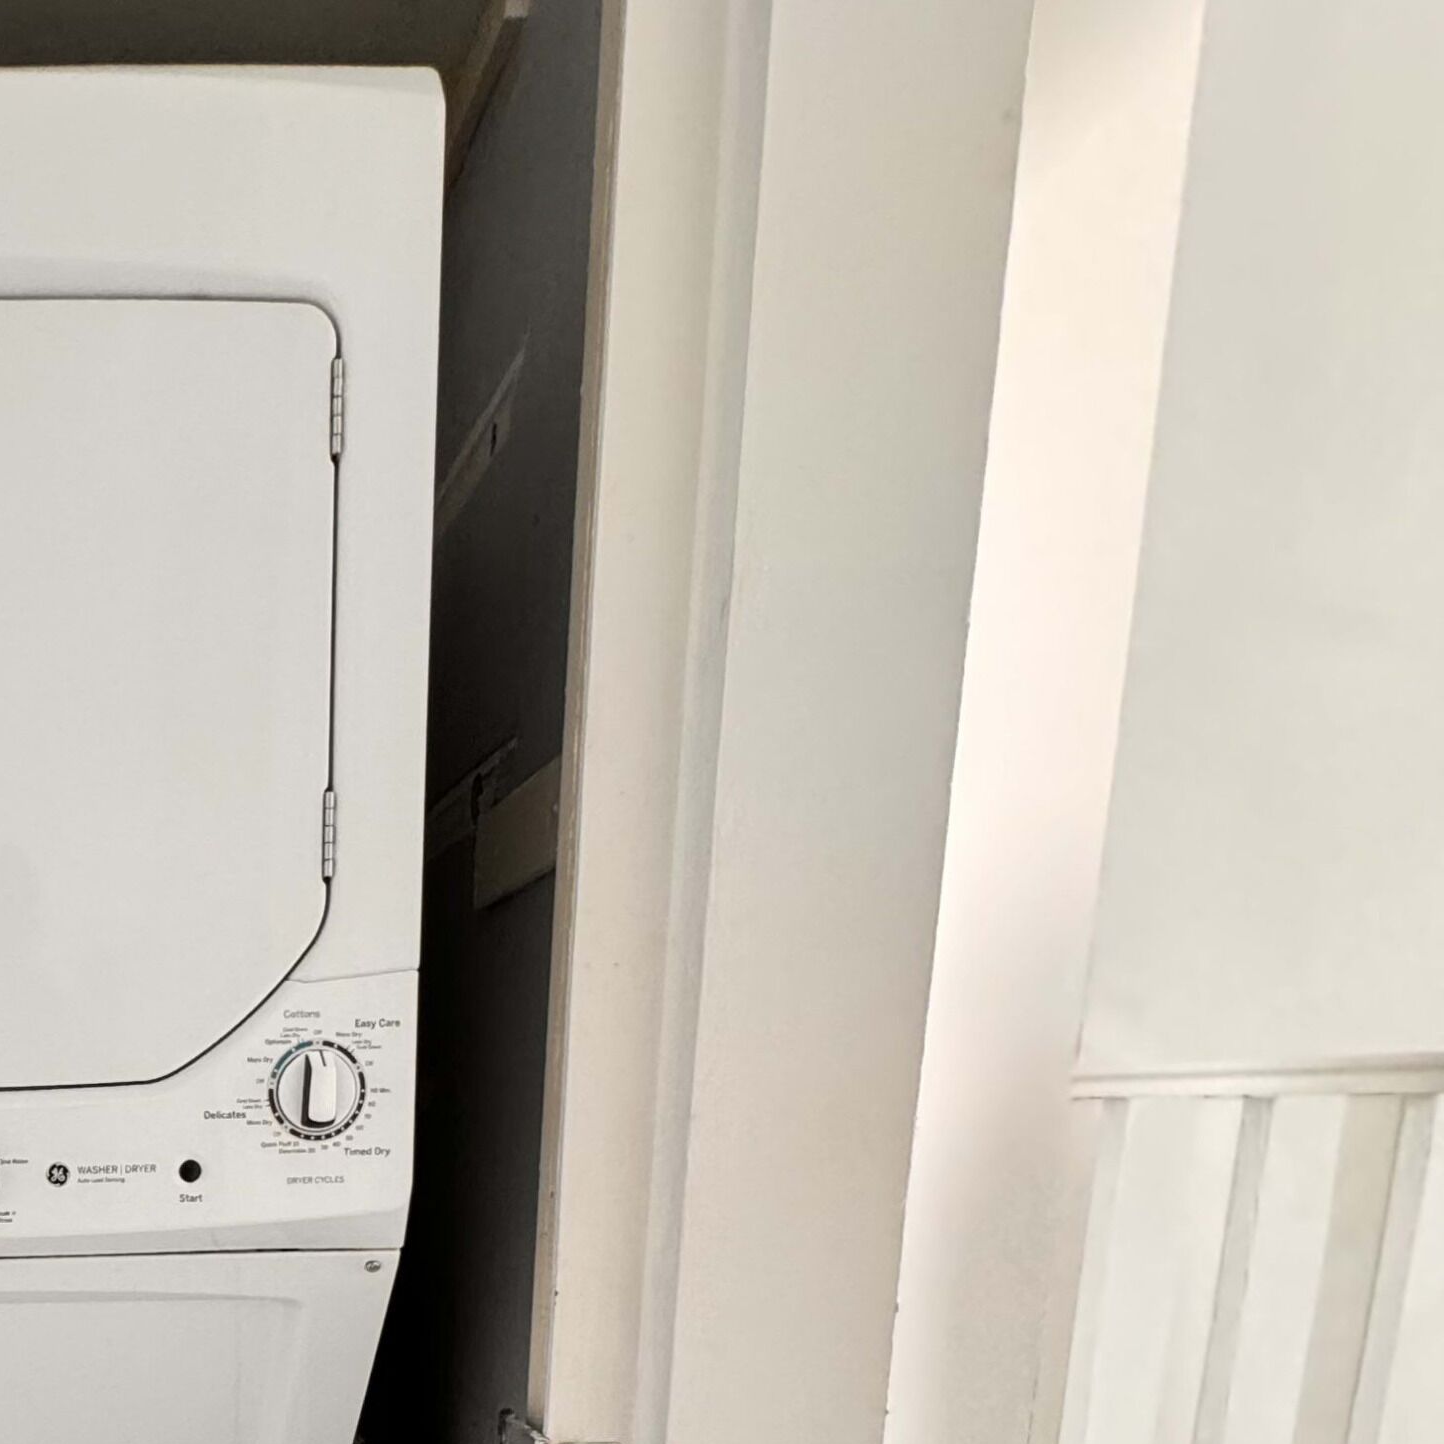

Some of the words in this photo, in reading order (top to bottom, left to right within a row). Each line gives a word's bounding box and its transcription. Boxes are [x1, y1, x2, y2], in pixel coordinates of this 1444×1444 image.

[283, 1009, 321, 1019] Cottons
[355, 1018, 377, 1030] Easy
[378, 1018, 401, 1028] Care
[263, 1056, 274, 1064] Dry
[203, 1110, 247, 1119] Delicates
[344, 1147, 372, 1156] Timed
[374, 1147, 391, 1157] Dry
[77, 1165, 118, 1175] WASHER
[124, 1164, 157, 1174] DRYER
[287, 1176, 313, 1185] DRYER
[314, 1175, 345, 1184] CYCLES
[179, 1193, 203, 1203] Start
